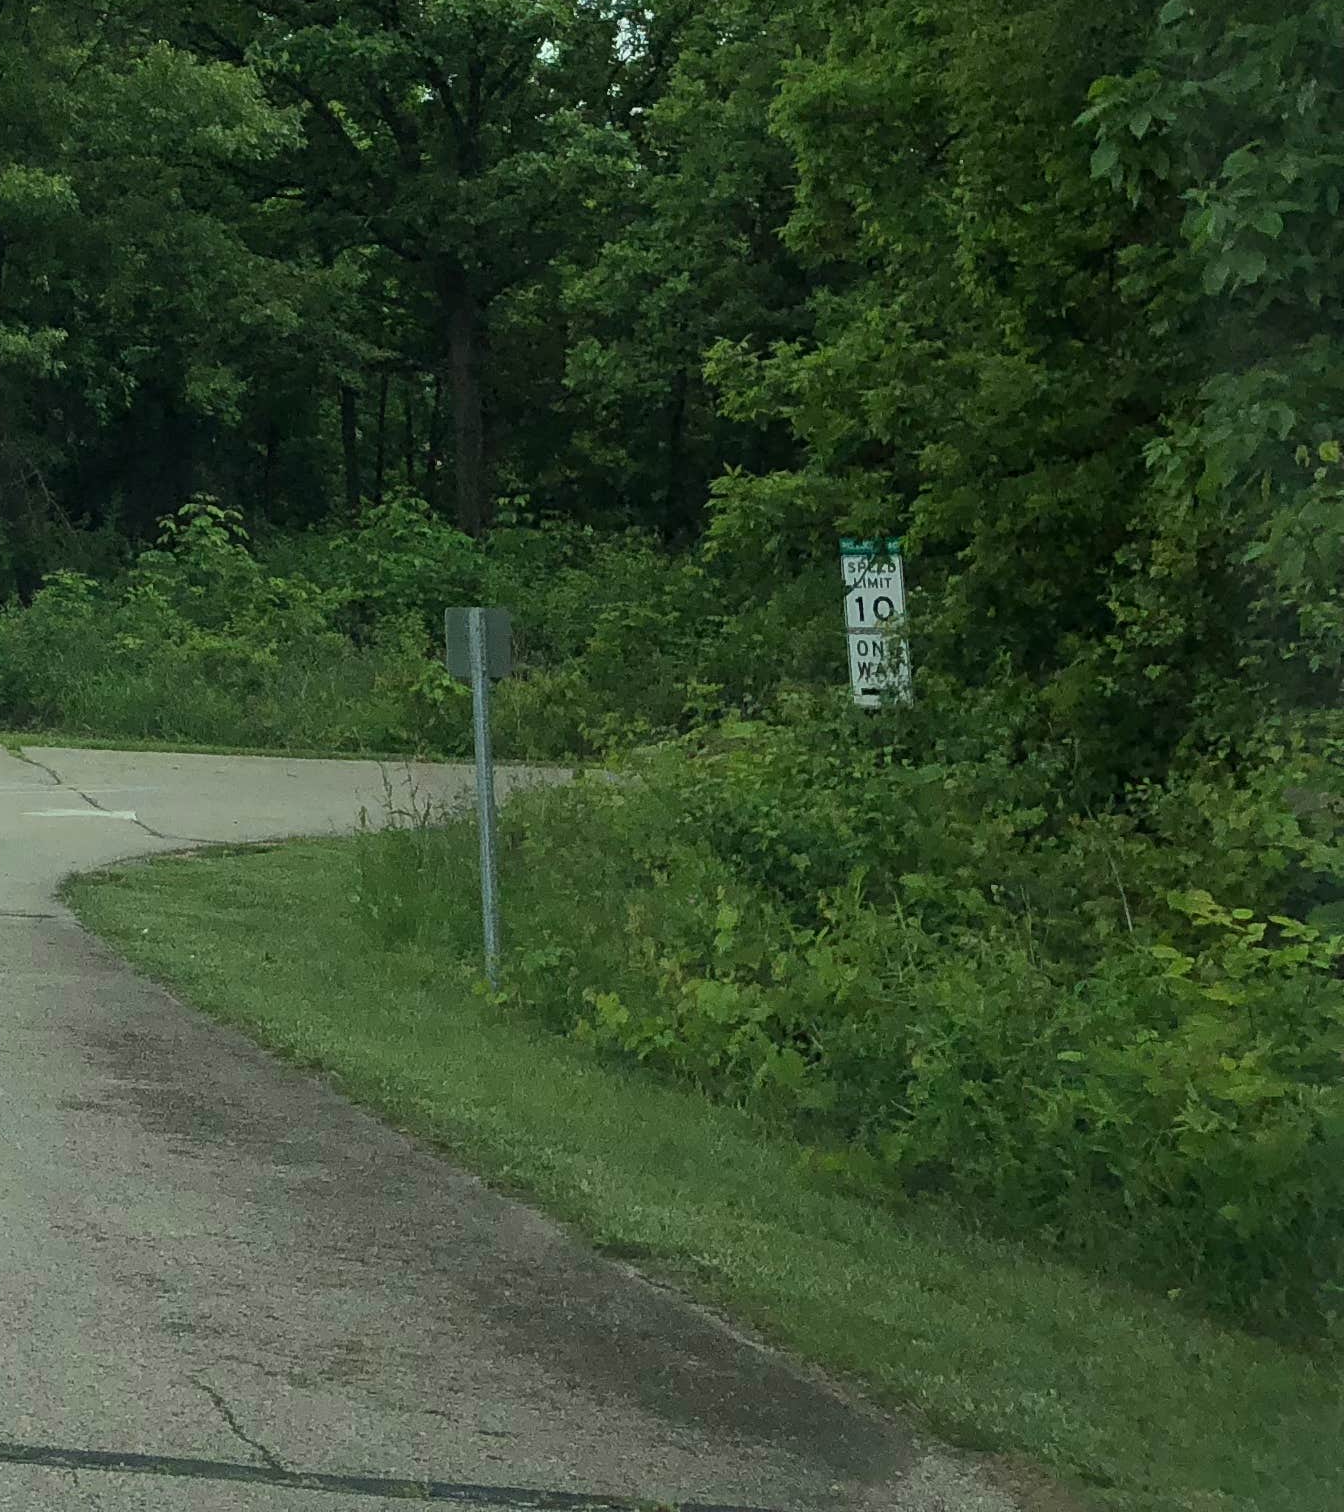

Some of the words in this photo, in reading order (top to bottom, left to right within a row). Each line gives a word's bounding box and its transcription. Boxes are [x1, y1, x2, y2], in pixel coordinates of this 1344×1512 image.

[853, 577, 892, 589] LIMIT
[855, 595, 895, 623] 10
[857, 639, 889, 659] ON
